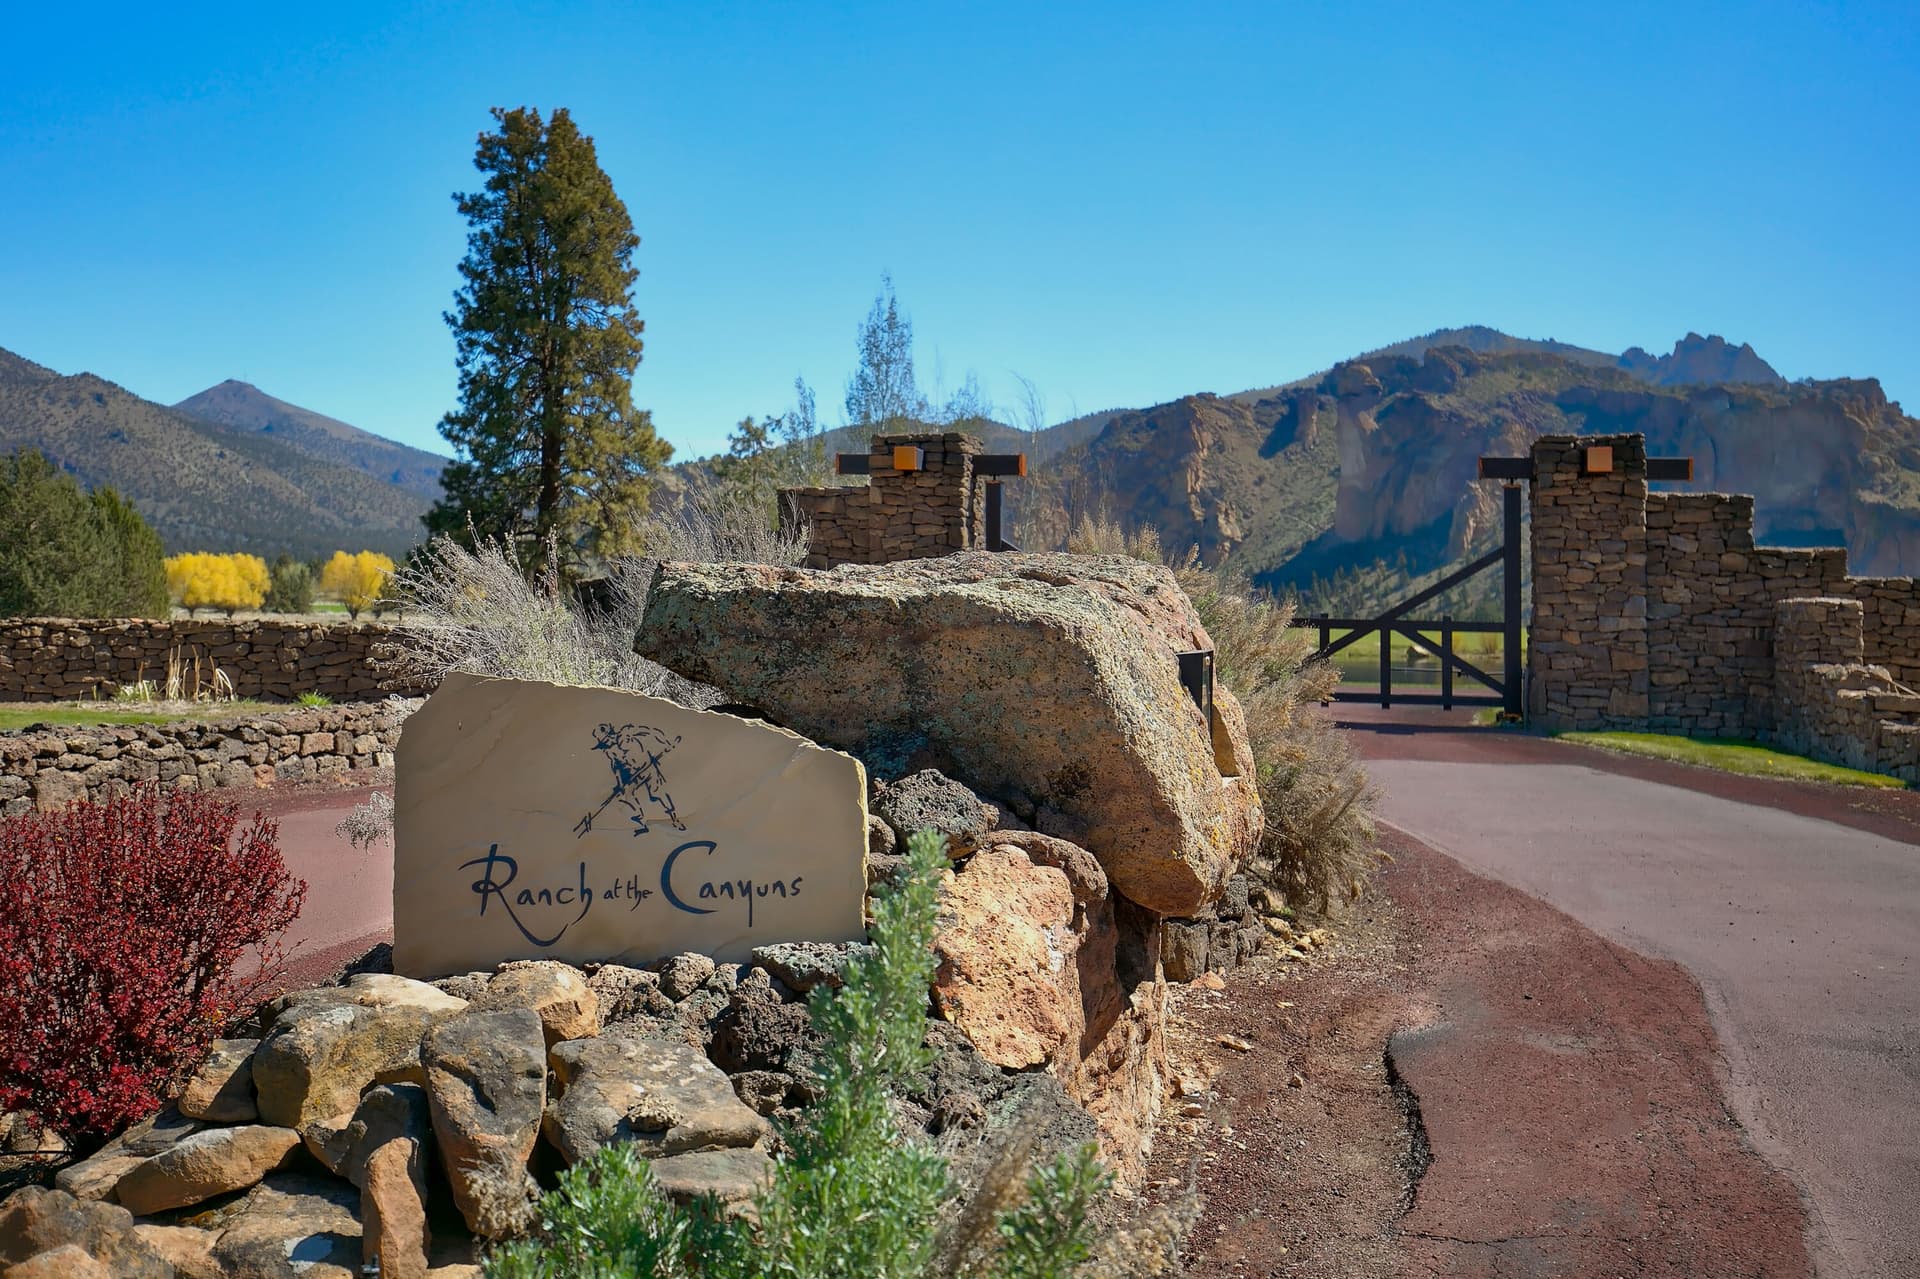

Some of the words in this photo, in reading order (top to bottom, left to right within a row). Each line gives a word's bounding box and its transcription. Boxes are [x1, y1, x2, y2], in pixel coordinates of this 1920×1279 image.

[458, 844, 593, 947] Ranch
[603, 878, 623, 900] at
[626, 874, 653, 912] the
